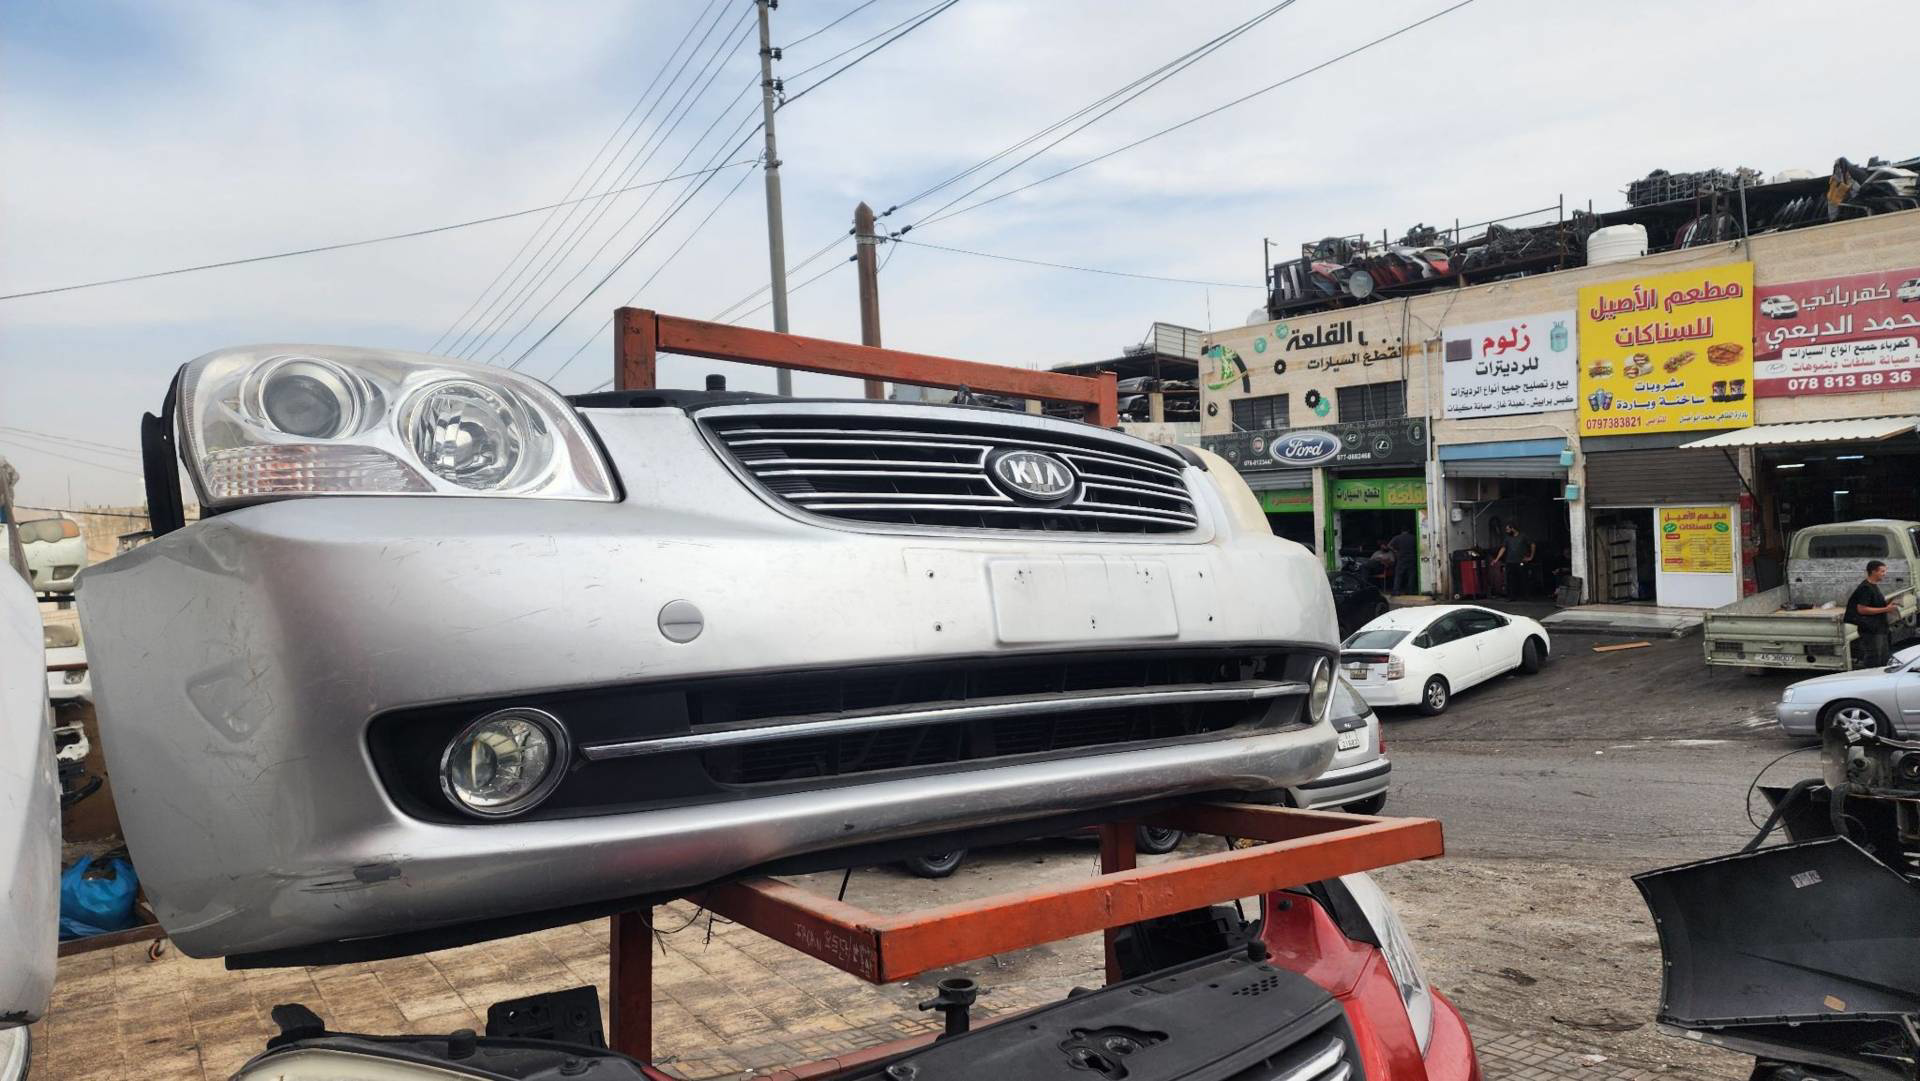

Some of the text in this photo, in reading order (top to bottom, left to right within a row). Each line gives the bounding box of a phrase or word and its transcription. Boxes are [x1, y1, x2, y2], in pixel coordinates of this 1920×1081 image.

[1590, 281, 1743, 321] مطعم الأصيل
[1801, 282, 1891, 310] كهربائي
[1286, 320, 1352, 351] القلعة
[1483, 323, 1531, 357] زلوم
[1615, 316, 1713, 347] للسناكات
[1766, 313, 1920, 349] حمد الدبعي
[1789, 345, 1827, 359] السيارات
[1854, 343, 1877, 355] جميع
[1880, 338, 1910, 352] كهرباء
[1308, 345, 1402, 373] لقطع السيارات
[1475, 357, 1539, 377] للرديترات
[1501, 384, 1521, 395] جميع
[1523, 379, 1549, 392] تصليح
[1635, 378, 1684, 392] مشروبات
[1788, 370, 1912, 391] 078 813 89 36
[1616, 394, 1704, 411] ساخنة وباردة
[1286, 437, 1324, 457] Ford
[1008, 459, 1066, 487] KIA
